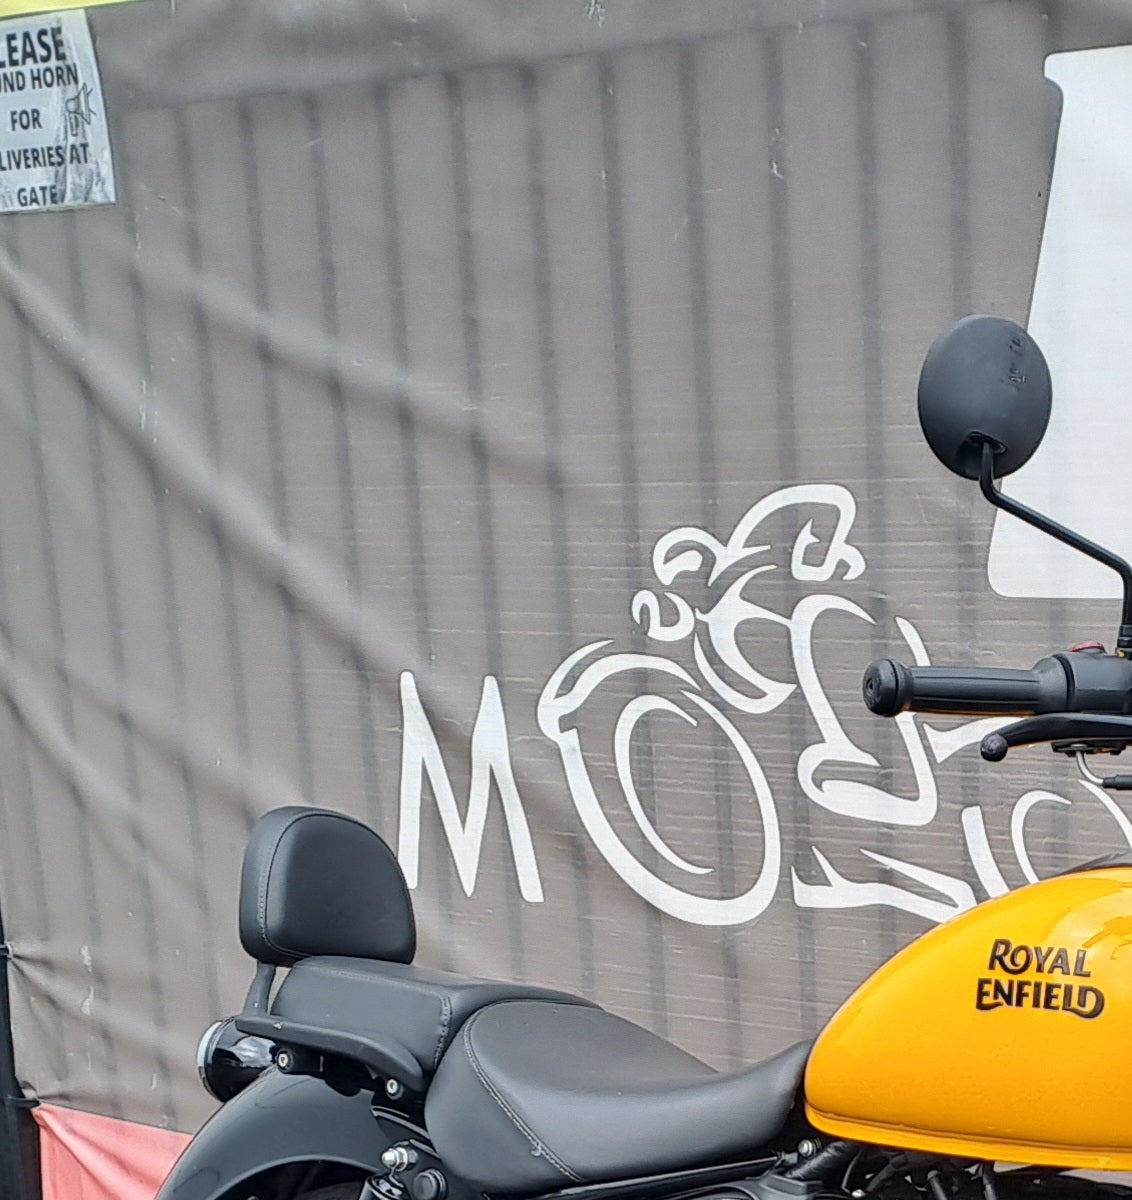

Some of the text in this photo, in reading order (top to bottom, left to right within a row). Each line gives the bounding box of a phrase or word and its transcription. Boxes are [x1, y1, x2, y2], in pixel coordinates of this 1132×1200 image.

[0, 63, 79, 93] ND HORN
[10, 108, 43, 132] FOR
[69, 142, 90, 165] AT
[17, 185, 59, 208] GATE
[988, 938, 1092, 978] ROYAL
[975, 977, 1106, 1020] ENFIELD
